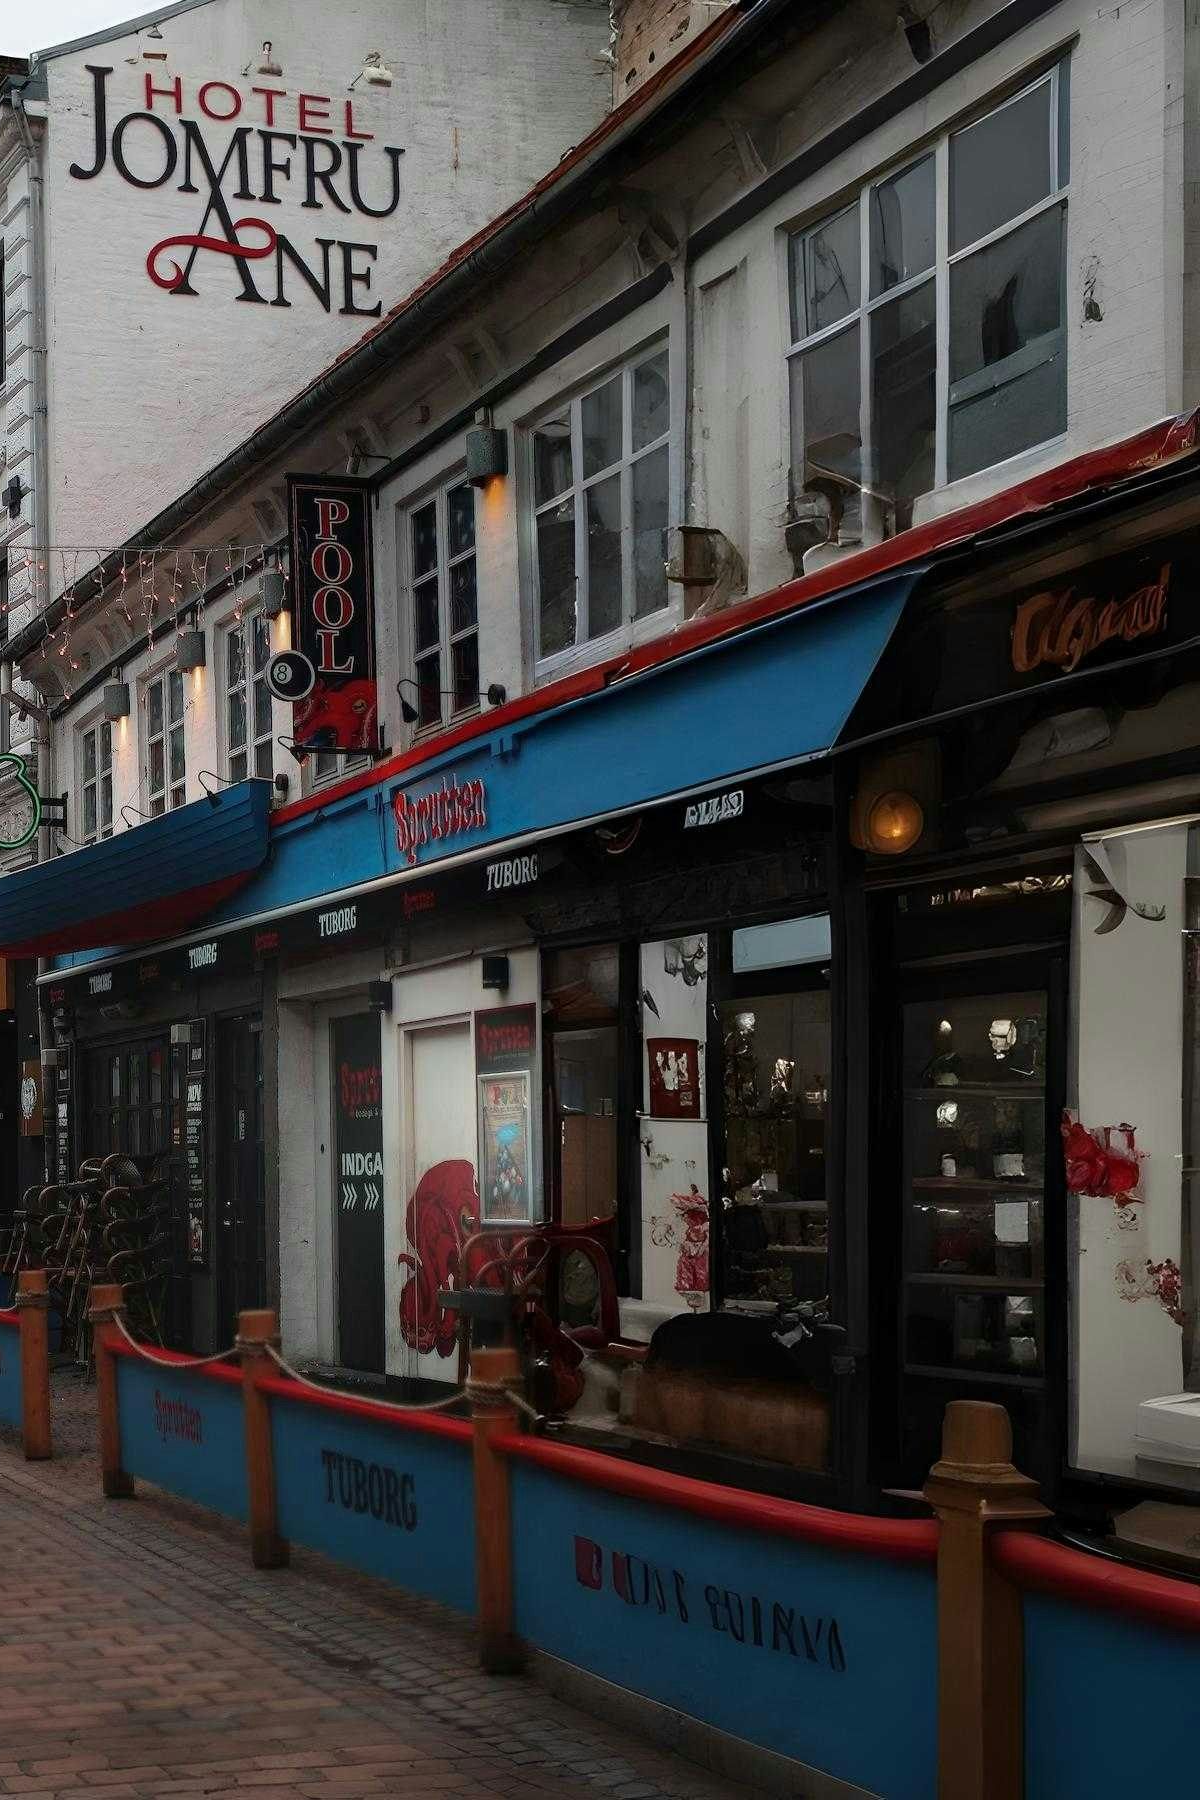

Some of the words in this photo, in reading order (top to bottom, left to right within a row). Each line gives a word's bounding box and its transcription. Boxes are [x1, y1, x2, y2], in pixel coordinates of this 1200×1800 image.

[144, 73, 375, 141] HOTEL
[69, 64, 406, 219] JOMFRU
[147, 183, 383, 317] ANE
[310, 498, 355, 674] POOL
[486, 853, 539, 891] TUBORG
[318, 905, 357, 937] TUBORG
[188, 943, 218, 969] TUBORG
[341, 1152, 383, 1176] INDGA
[321, 1449, 418, 1532] TUBORG
